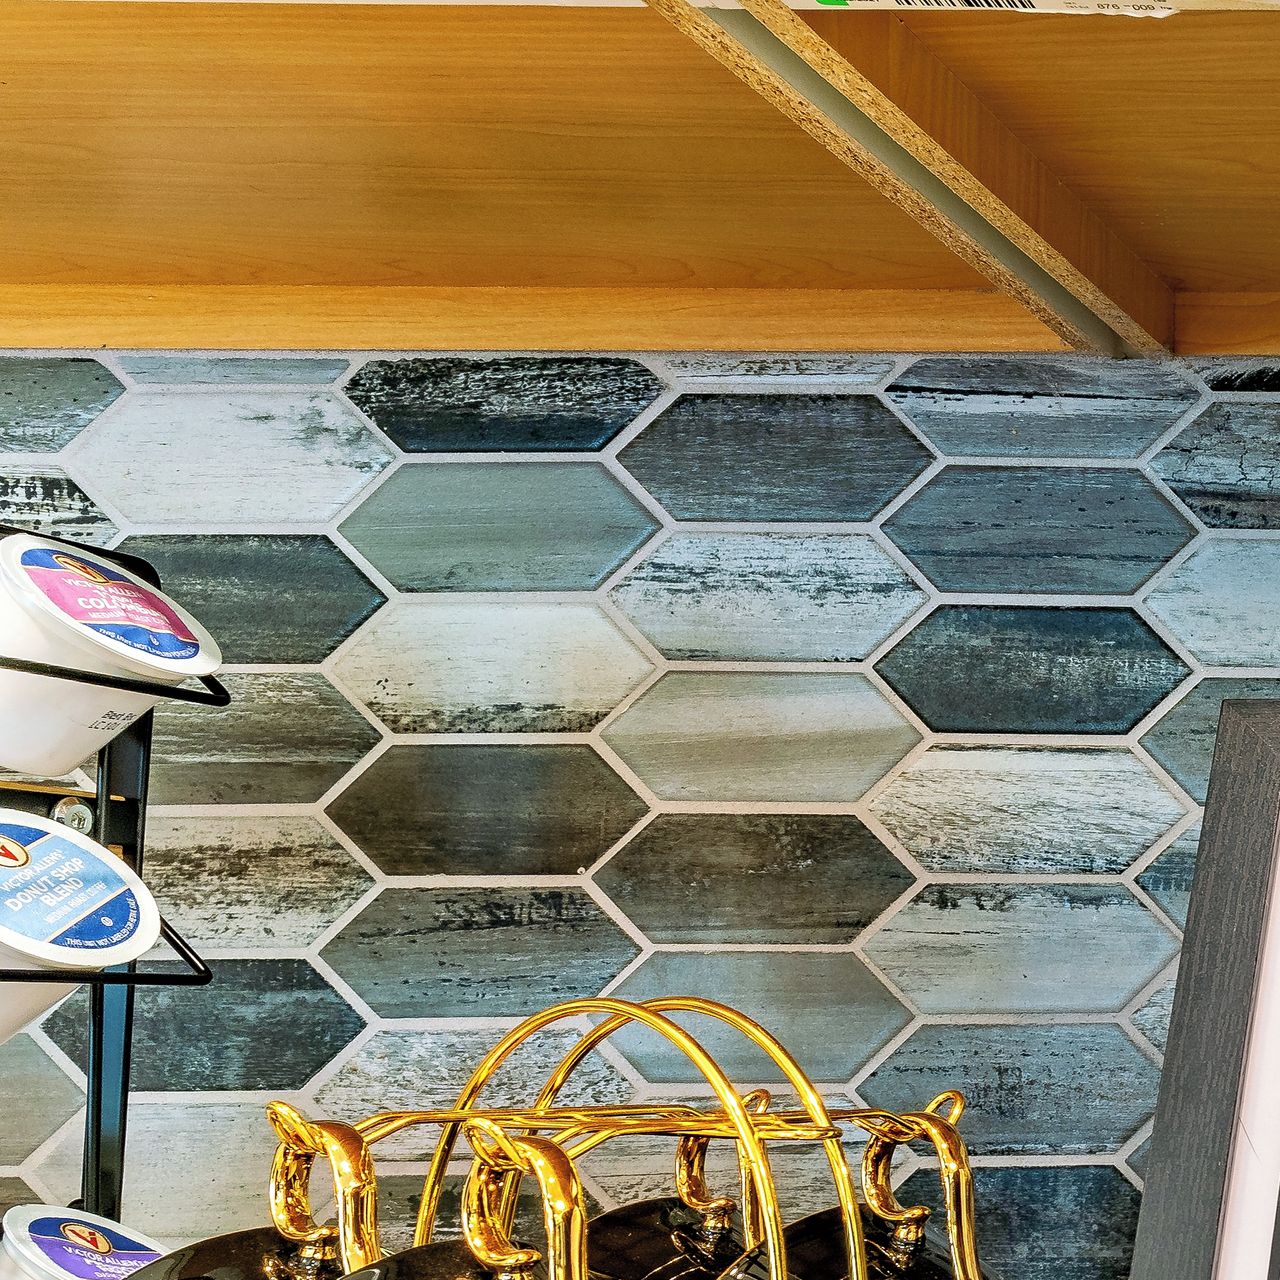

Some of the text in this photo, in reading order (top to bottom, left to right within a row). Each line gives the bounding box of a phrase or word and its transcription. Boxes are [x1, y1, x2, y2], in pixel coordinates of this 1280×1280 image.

[0, 868, 35, 892] VICTOR
[4, 857, 85, 912] DONUT SHOP
[39, 877, 84, 907] BLEND
[63, 1246, 104, 1262] VICTOR
